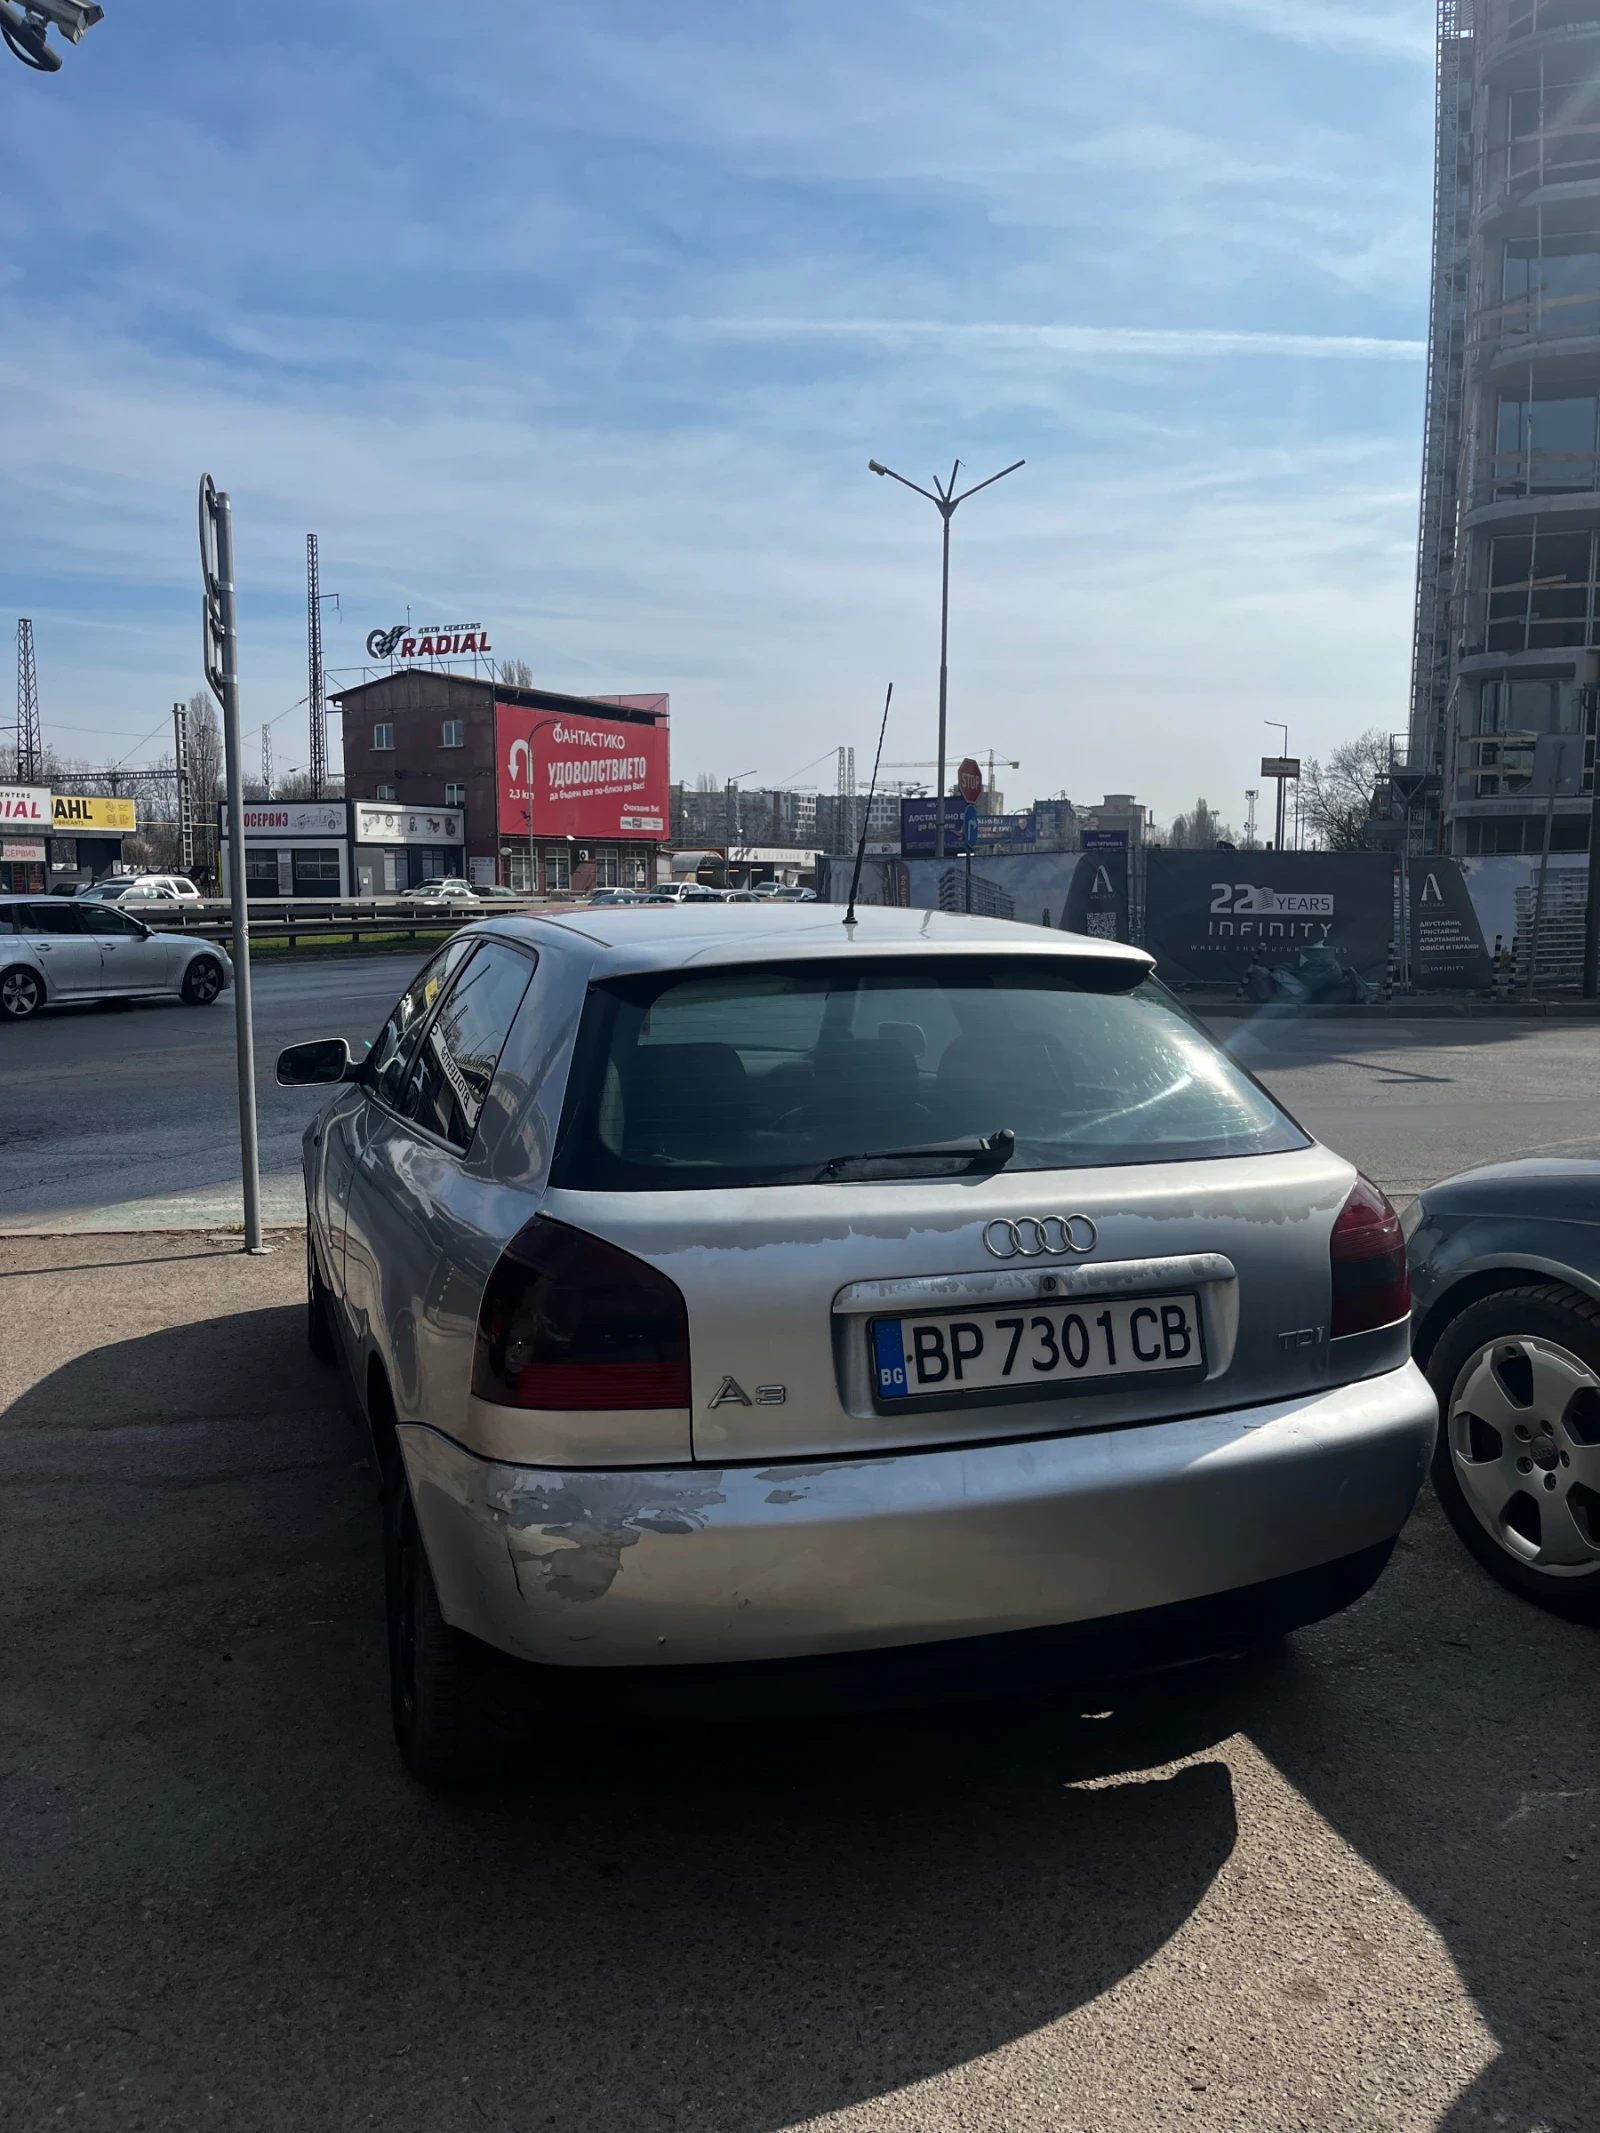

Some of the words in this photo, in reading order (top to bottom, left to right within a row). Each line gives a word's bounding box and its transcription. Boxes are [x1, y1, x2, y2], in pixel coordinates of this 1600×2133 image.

[401, 632, 491, 657] RADIAL
[553, 722, 625, 749] ФАНТАСТИКО
[548, 756, 646, 788] УДОВОЛСТВИЕТО
[961, 772, 980, 790] STOP
[509, 789, 520, 800] 2,3
[51, 798, 93, 820] AHL
[5, 849, 36, 858] СЕРВИЗ
[1210, 883, 1254, 914] 22
[1276, 897, 1330, 911] YEARS
[1208, 921, 1332, 937] INFINITY
[912, 1321, 984, 1384] BP
[995, 1310, 1117, 1376] 7301
[1129, 1304, 1191, 1362] CB
[881, 1367, 904, 1386] BG
[707, 1375, 786, 1409] A3
